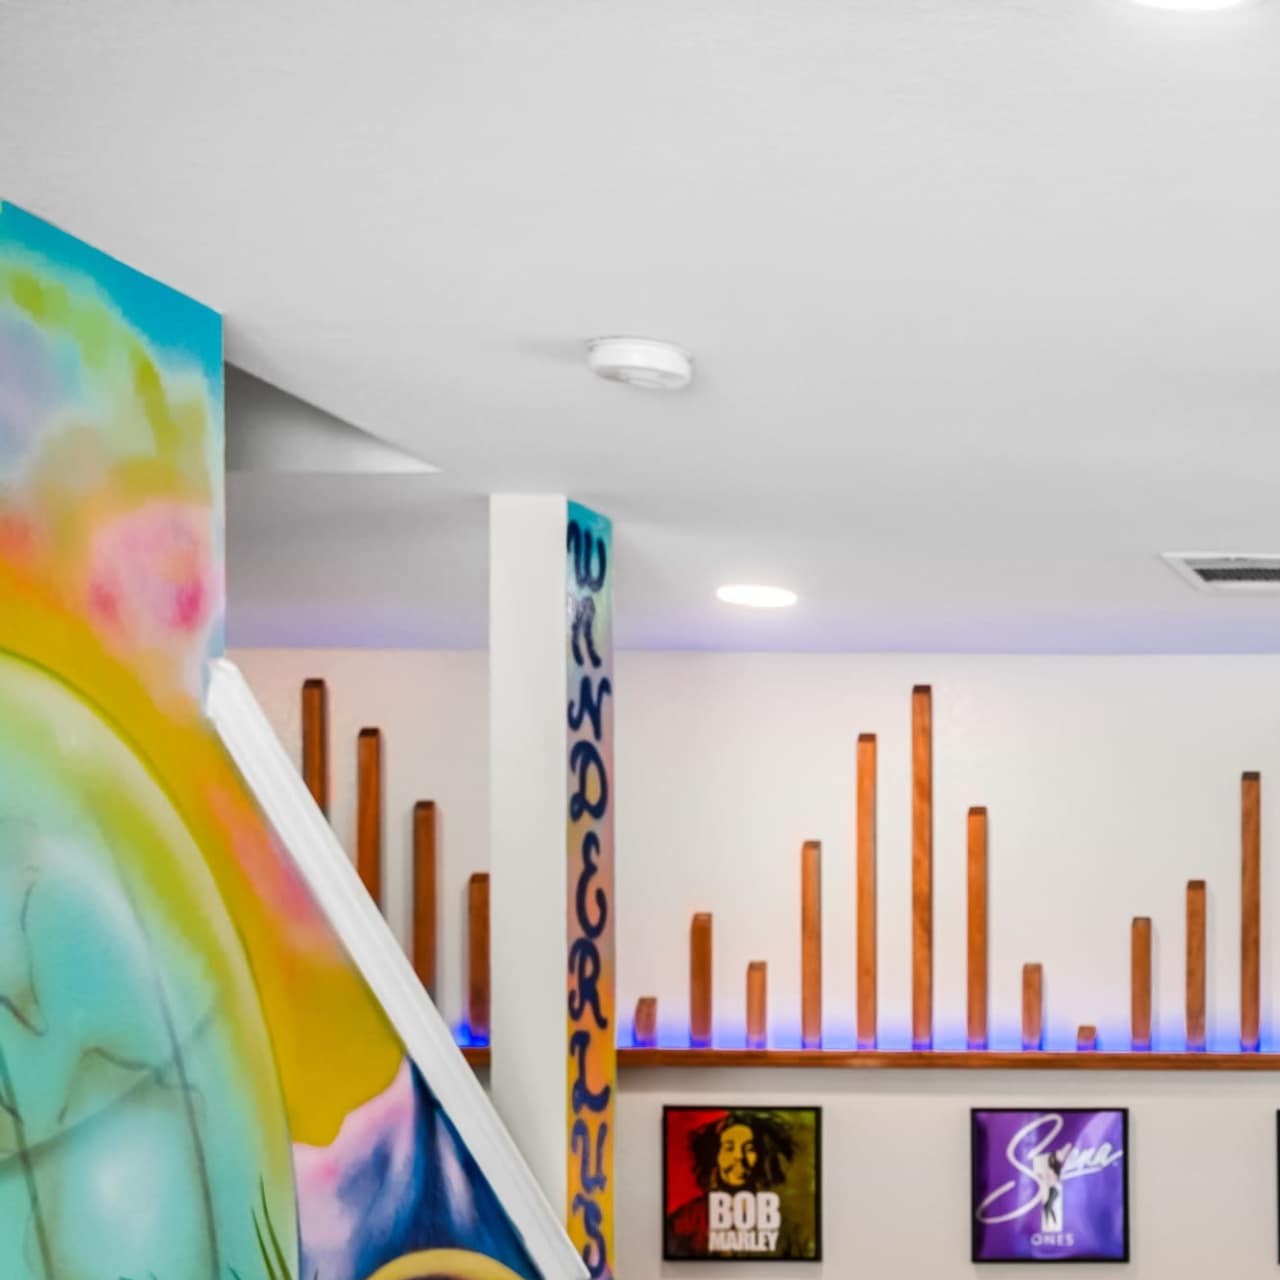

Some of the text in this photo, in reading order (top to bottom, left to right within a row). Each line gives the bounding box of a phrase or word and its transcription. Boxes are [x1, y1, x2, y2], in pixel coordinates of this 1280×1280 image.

[708, 1190, 781, 1232] BOB
[708, 1231, 779, 1252] MARLEY
[1031, 1233, 1074, 1246] ONES
